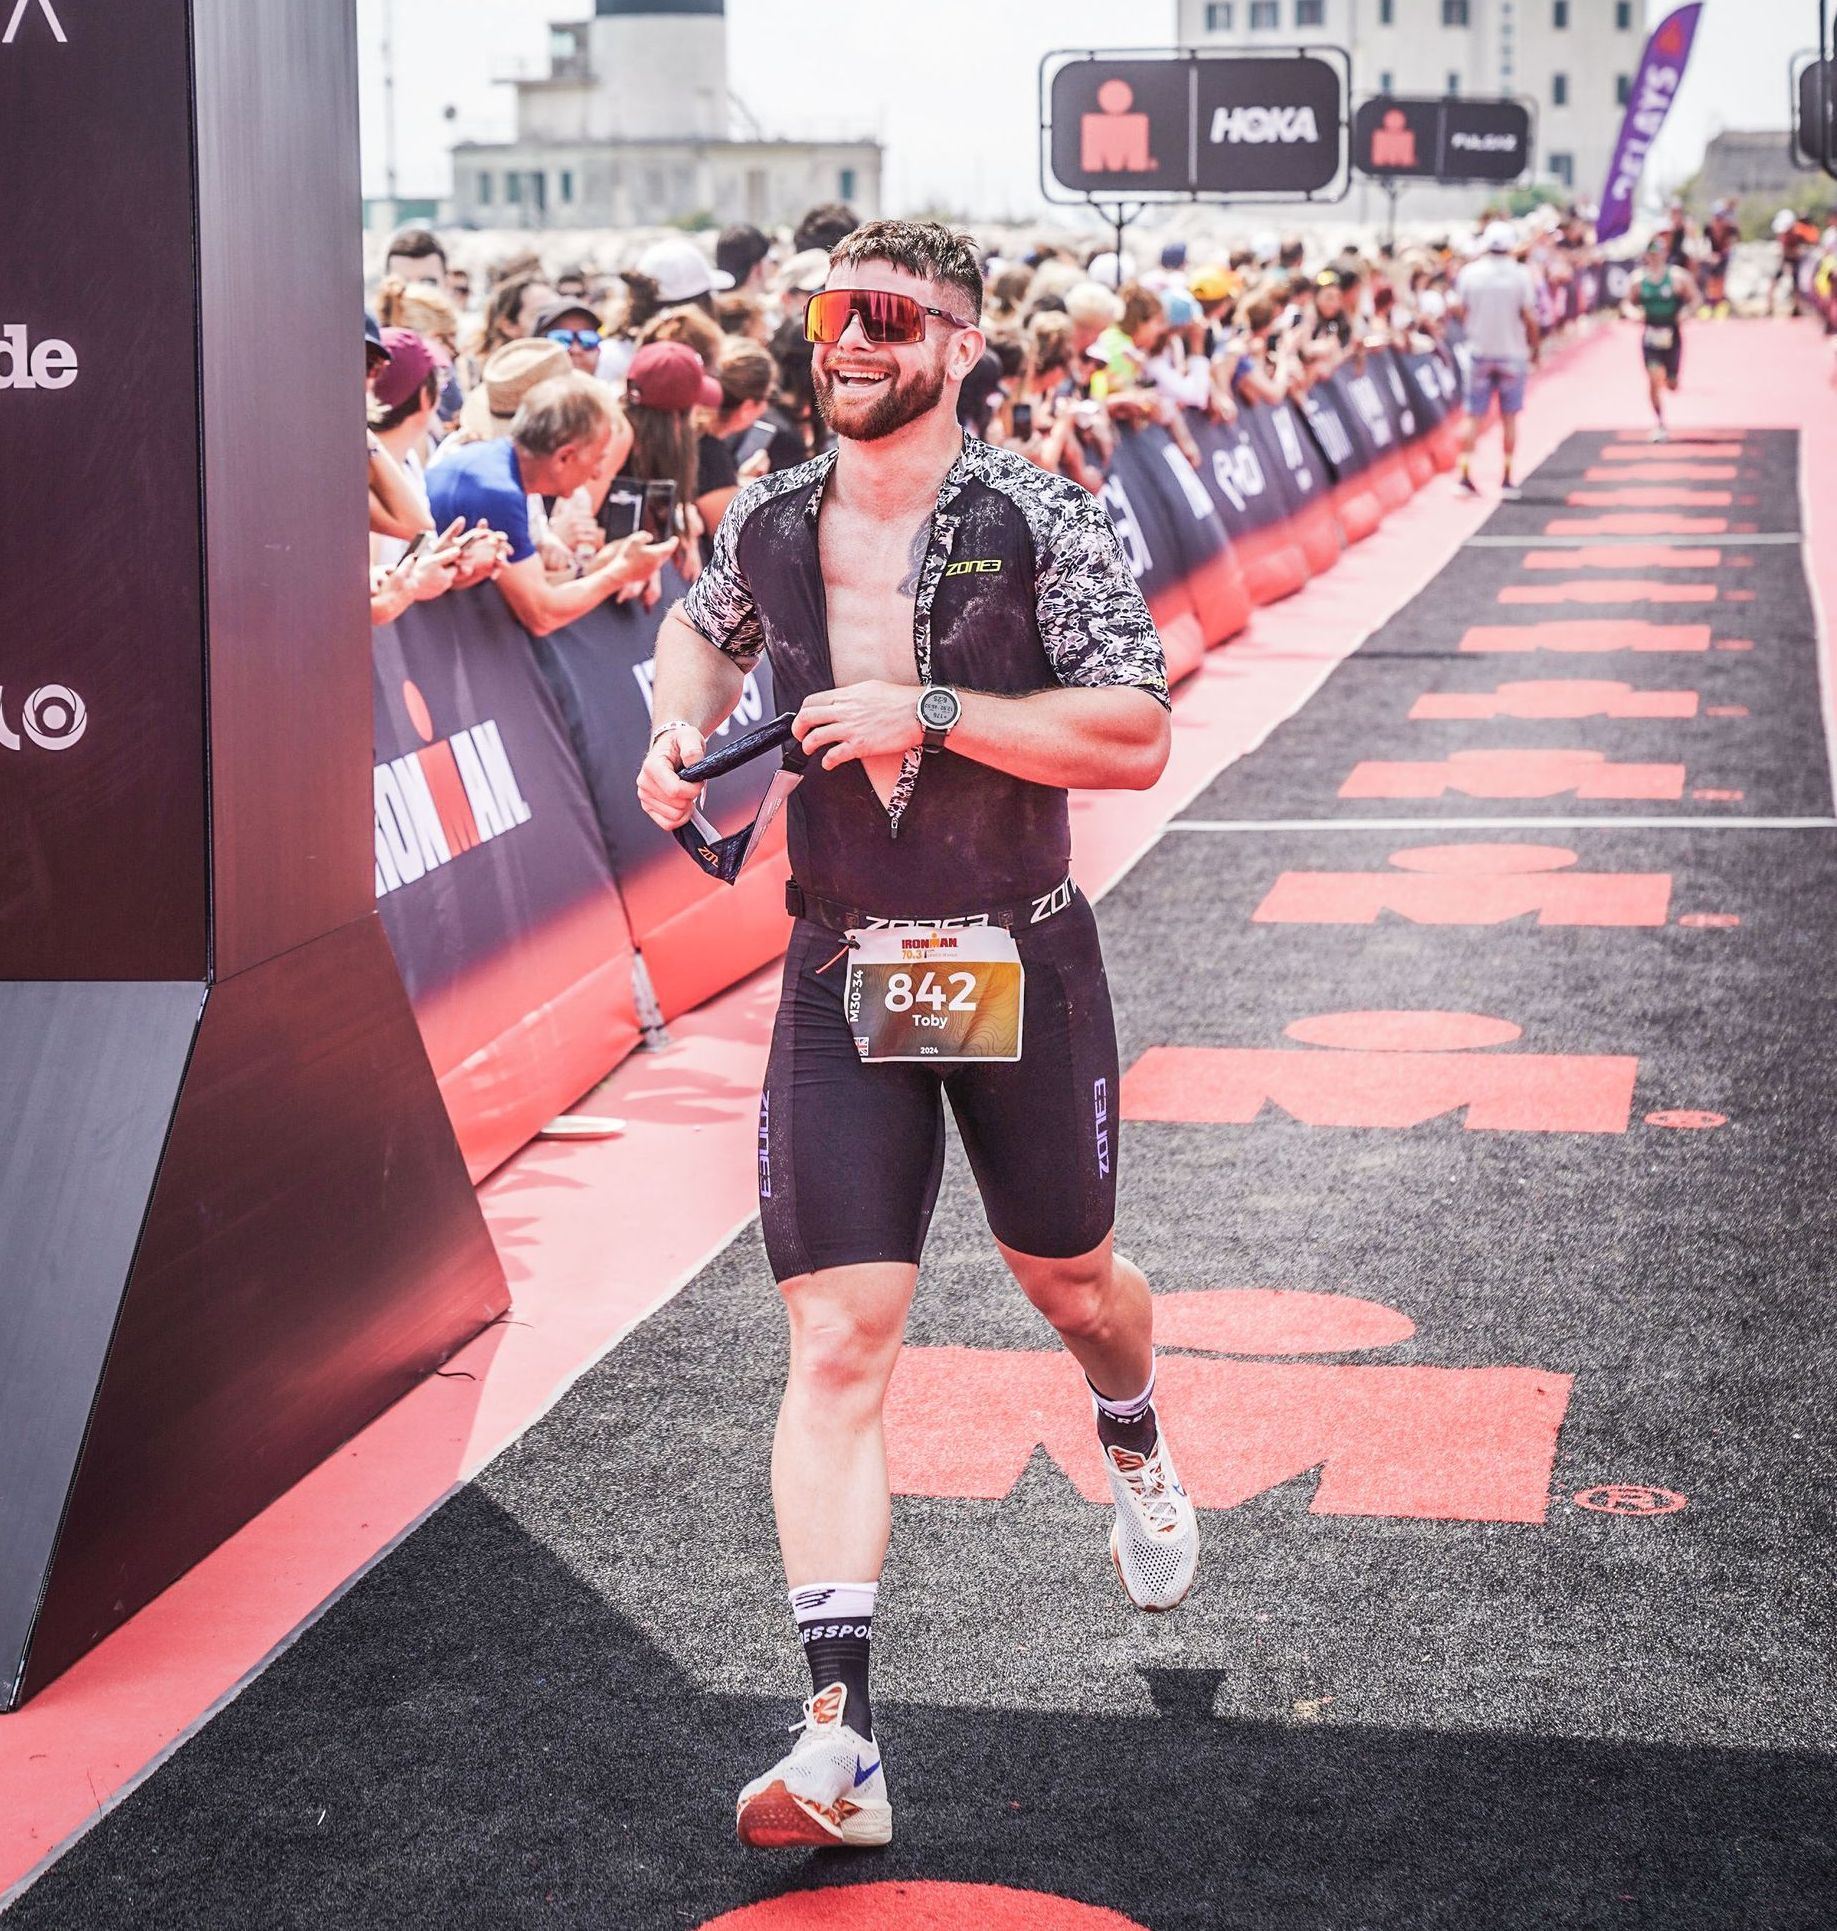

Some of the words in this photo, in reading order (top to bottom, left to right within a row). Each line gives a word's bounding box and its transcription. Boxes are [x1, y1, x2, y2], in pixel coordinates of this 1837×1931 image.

[1210, 106, 1319, 144] HOKA
[945, 559, 1002, 577] ZONE3
[374, 719, 532, 899] ONMAN
[901, 932, 958, 949] IRONMAN
[902, 949, 923, 960] 70.3
[849, 969, 865, 1023] M30-34
[884, 971, 977, 1013] 842
[912, 1014, 949, 1029] Toby
[920, 1046, 939, 1055] 2024
[1094, 1077, 1110, 1180] ZONE3
